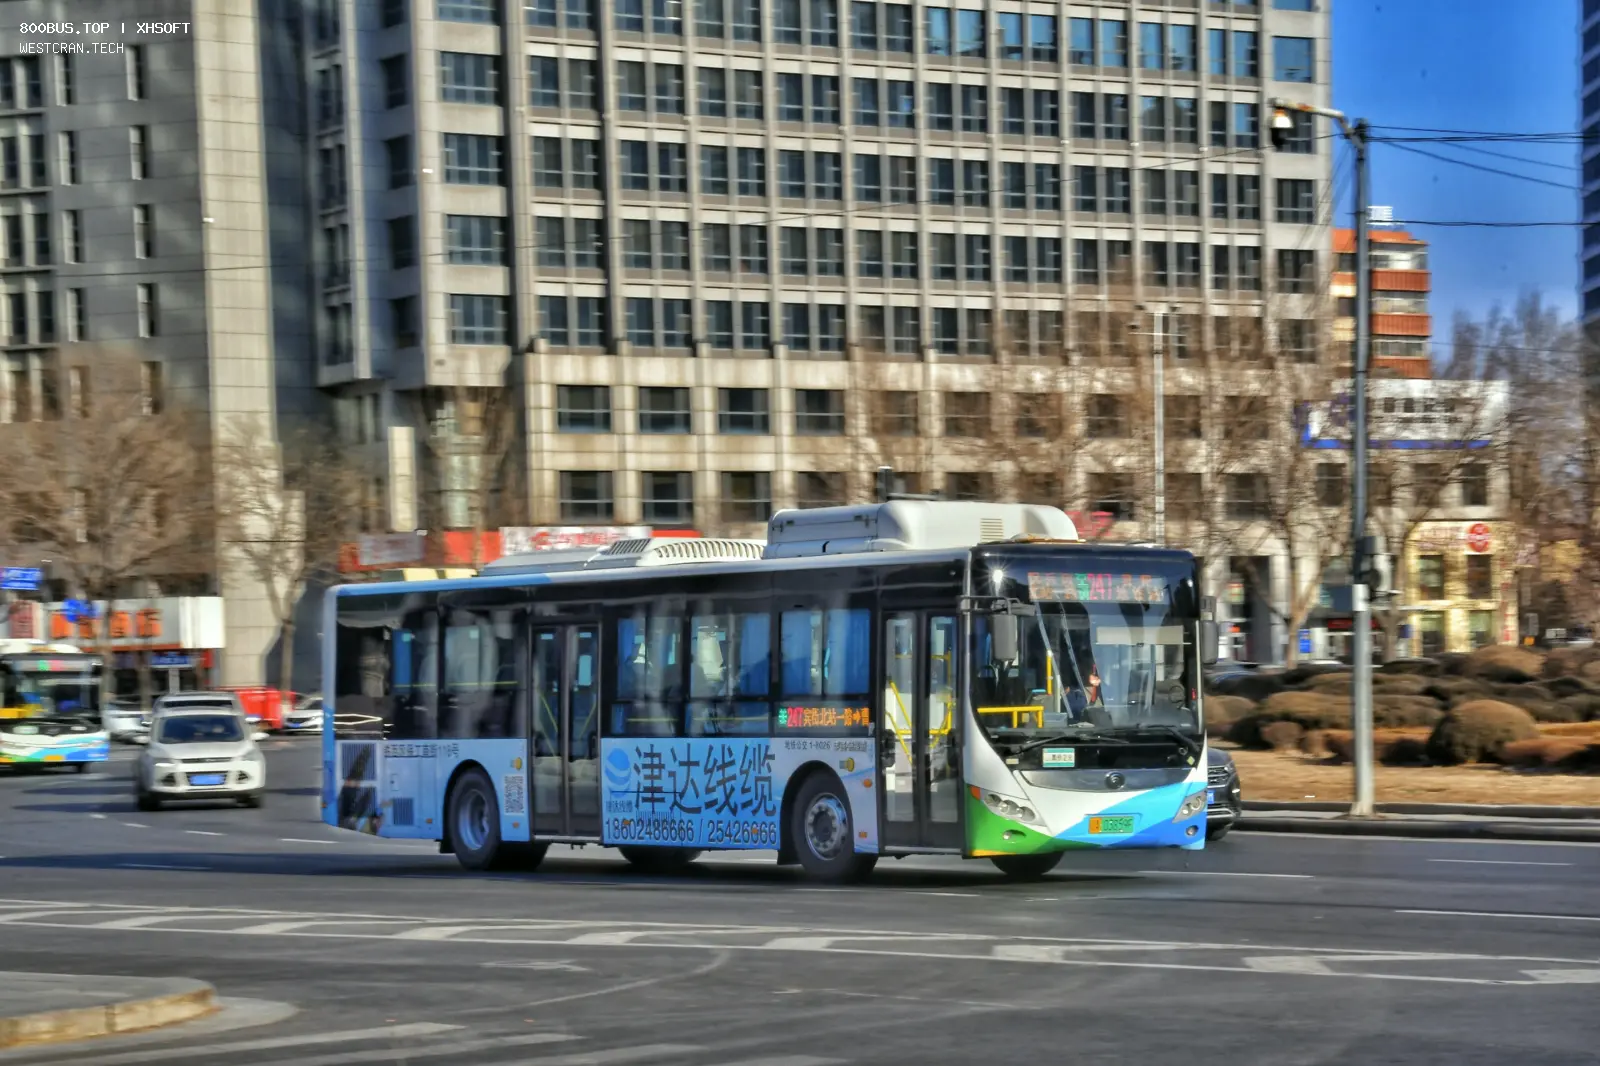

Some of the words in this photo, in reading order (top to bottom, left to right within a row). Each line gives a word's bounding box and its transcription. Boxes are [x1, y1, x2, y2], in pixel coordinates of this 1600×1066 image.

[1086, 573, 1113, 600] 247
[787, 706, 804, 727] 247
[634, 743, 776, 817] 津达线缆
[605, 818, 695, 842] 18602486666
[707, 820, 777, 845] 25426666
